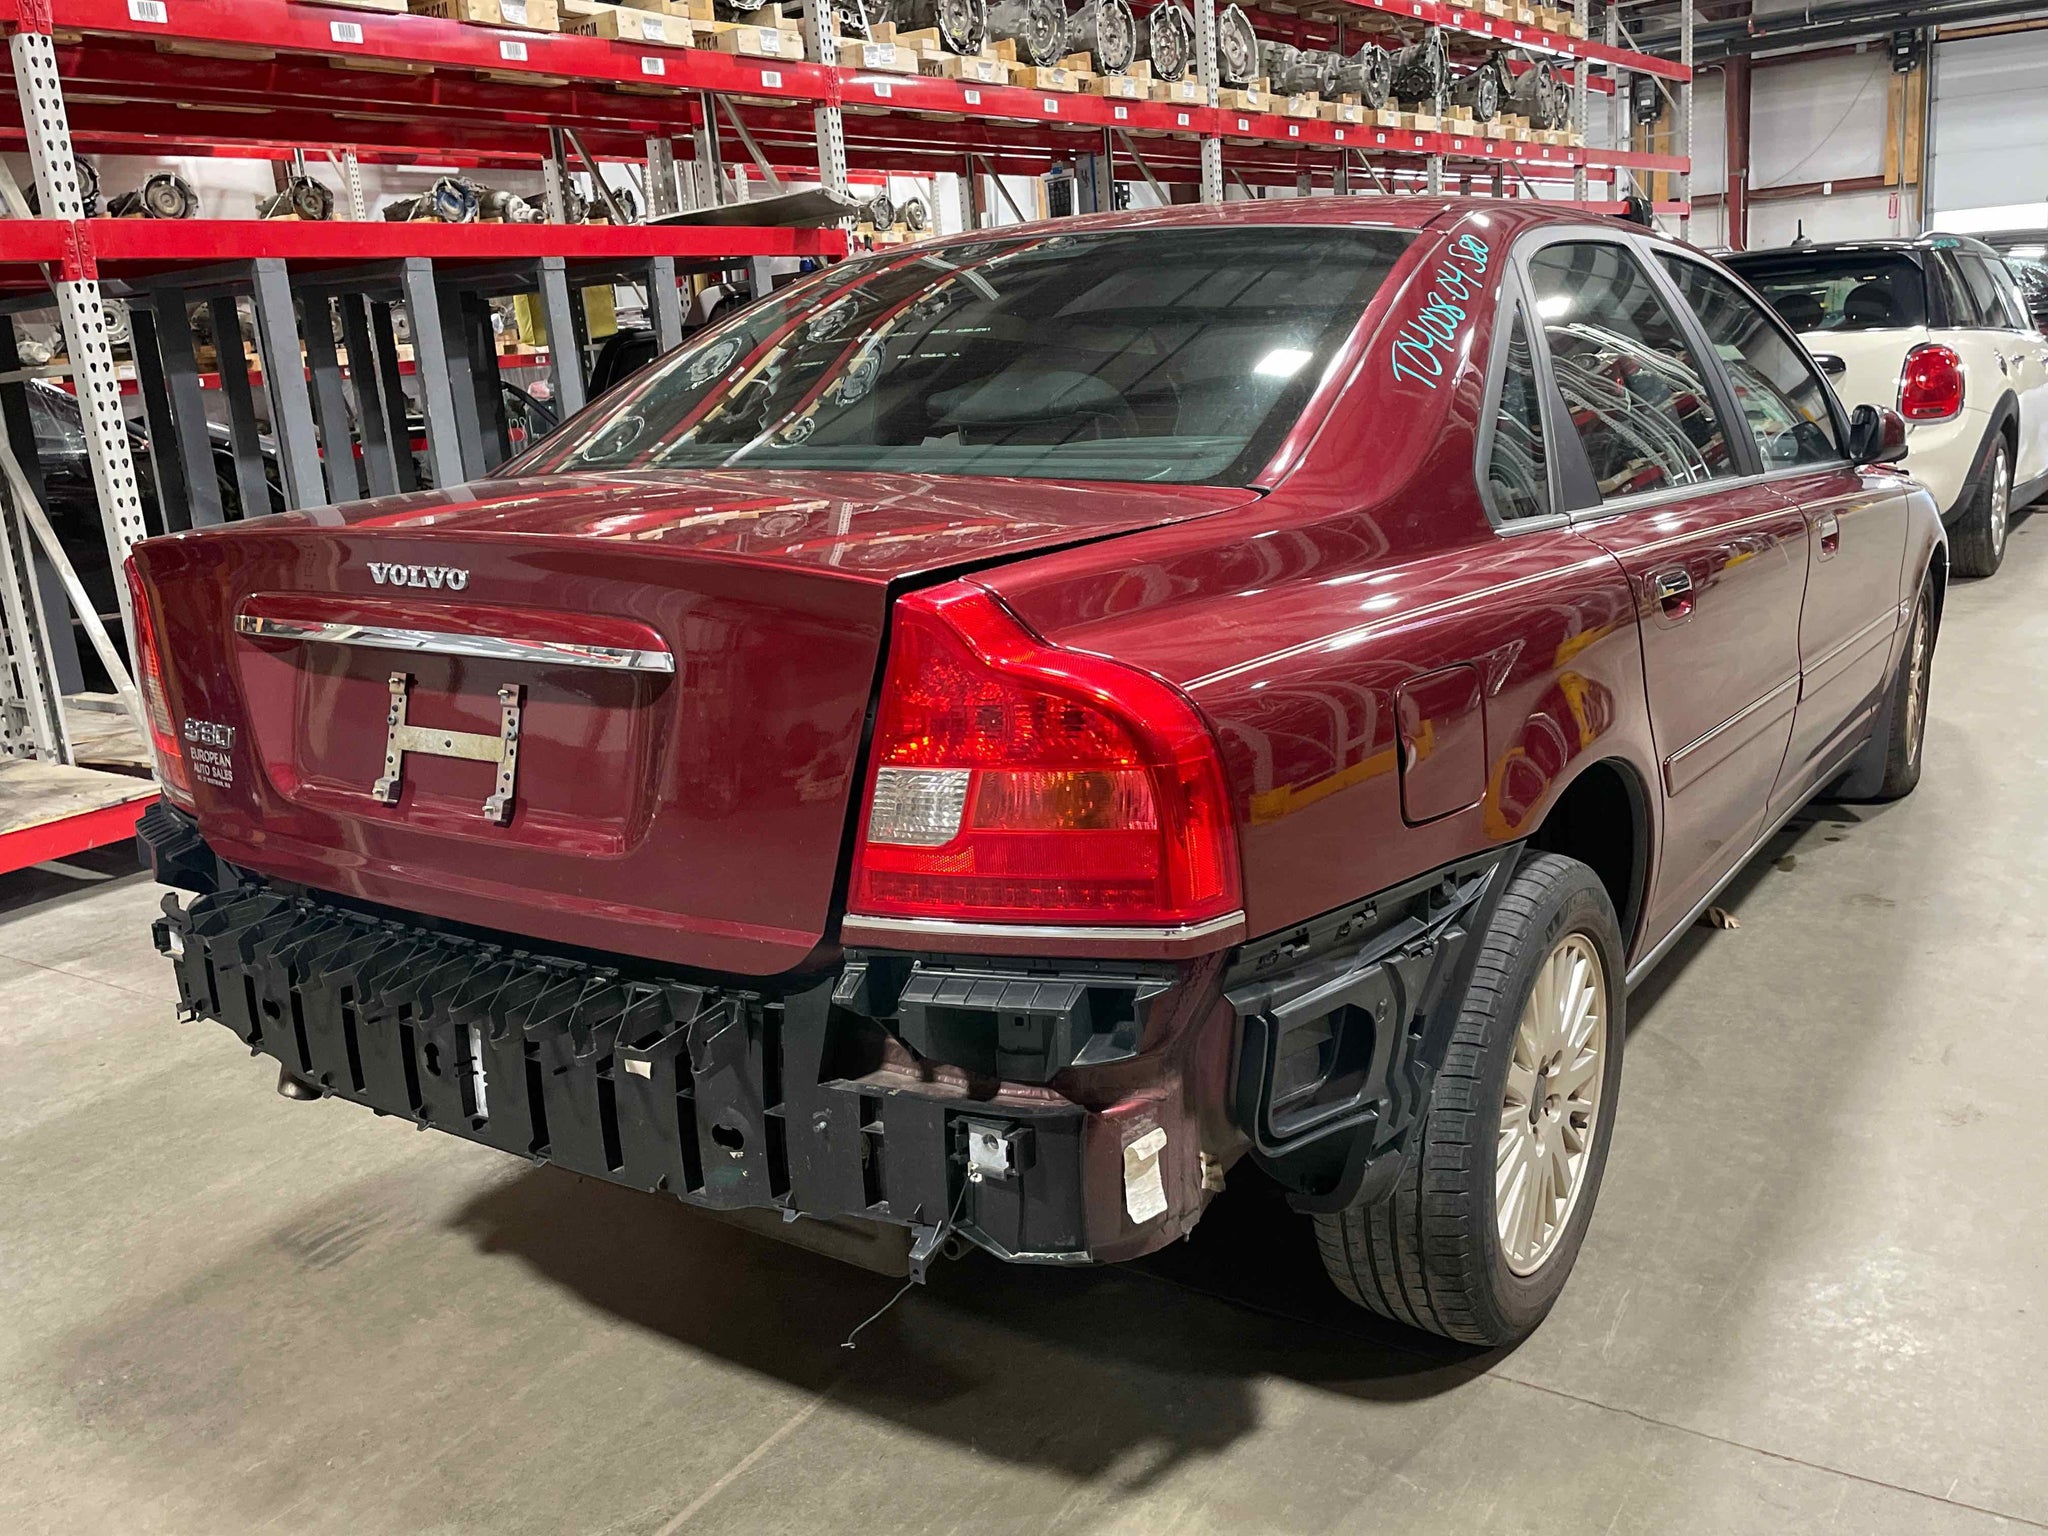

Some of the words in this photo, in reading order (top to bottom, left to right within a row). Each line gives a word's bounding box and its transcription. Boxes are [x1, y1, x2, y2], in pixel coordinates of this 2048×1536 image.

[366, 561, 469, 591] VOLVO
[190, 746, 232, 769] EUROPEAN
[193, 761, 210, 776] AUTO
[211, 766, 233, 782] SALES
